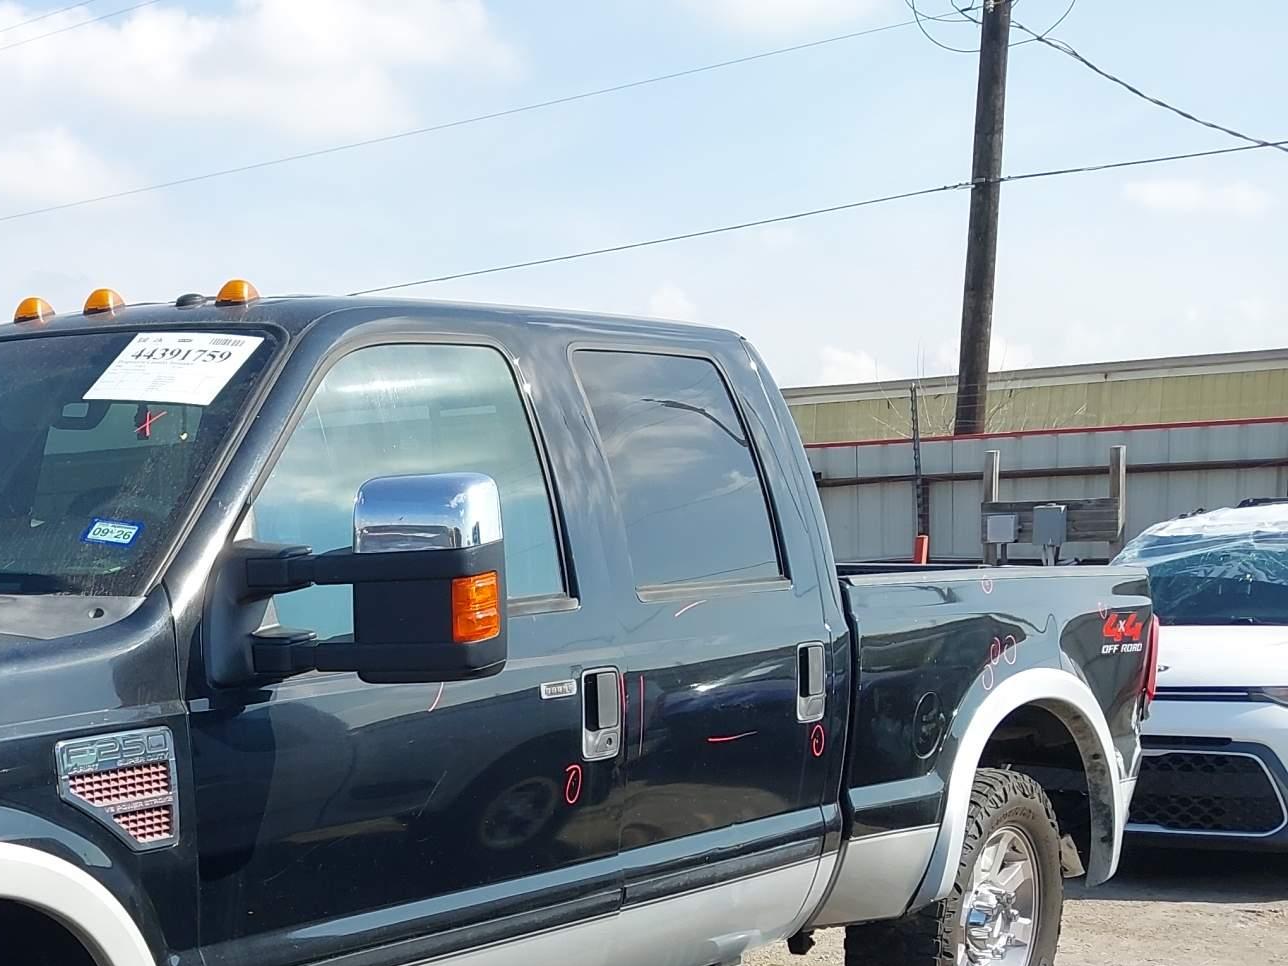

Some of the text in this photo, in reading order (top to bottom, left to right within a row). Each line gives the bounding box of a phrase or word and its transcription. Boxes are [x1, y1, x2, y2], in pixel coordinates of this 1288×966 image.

[131, 347, 232, 363] 44391759
[92, 527, 132, 540] 09 26
[1101, 642, 1143, 654] OFF ROAD
